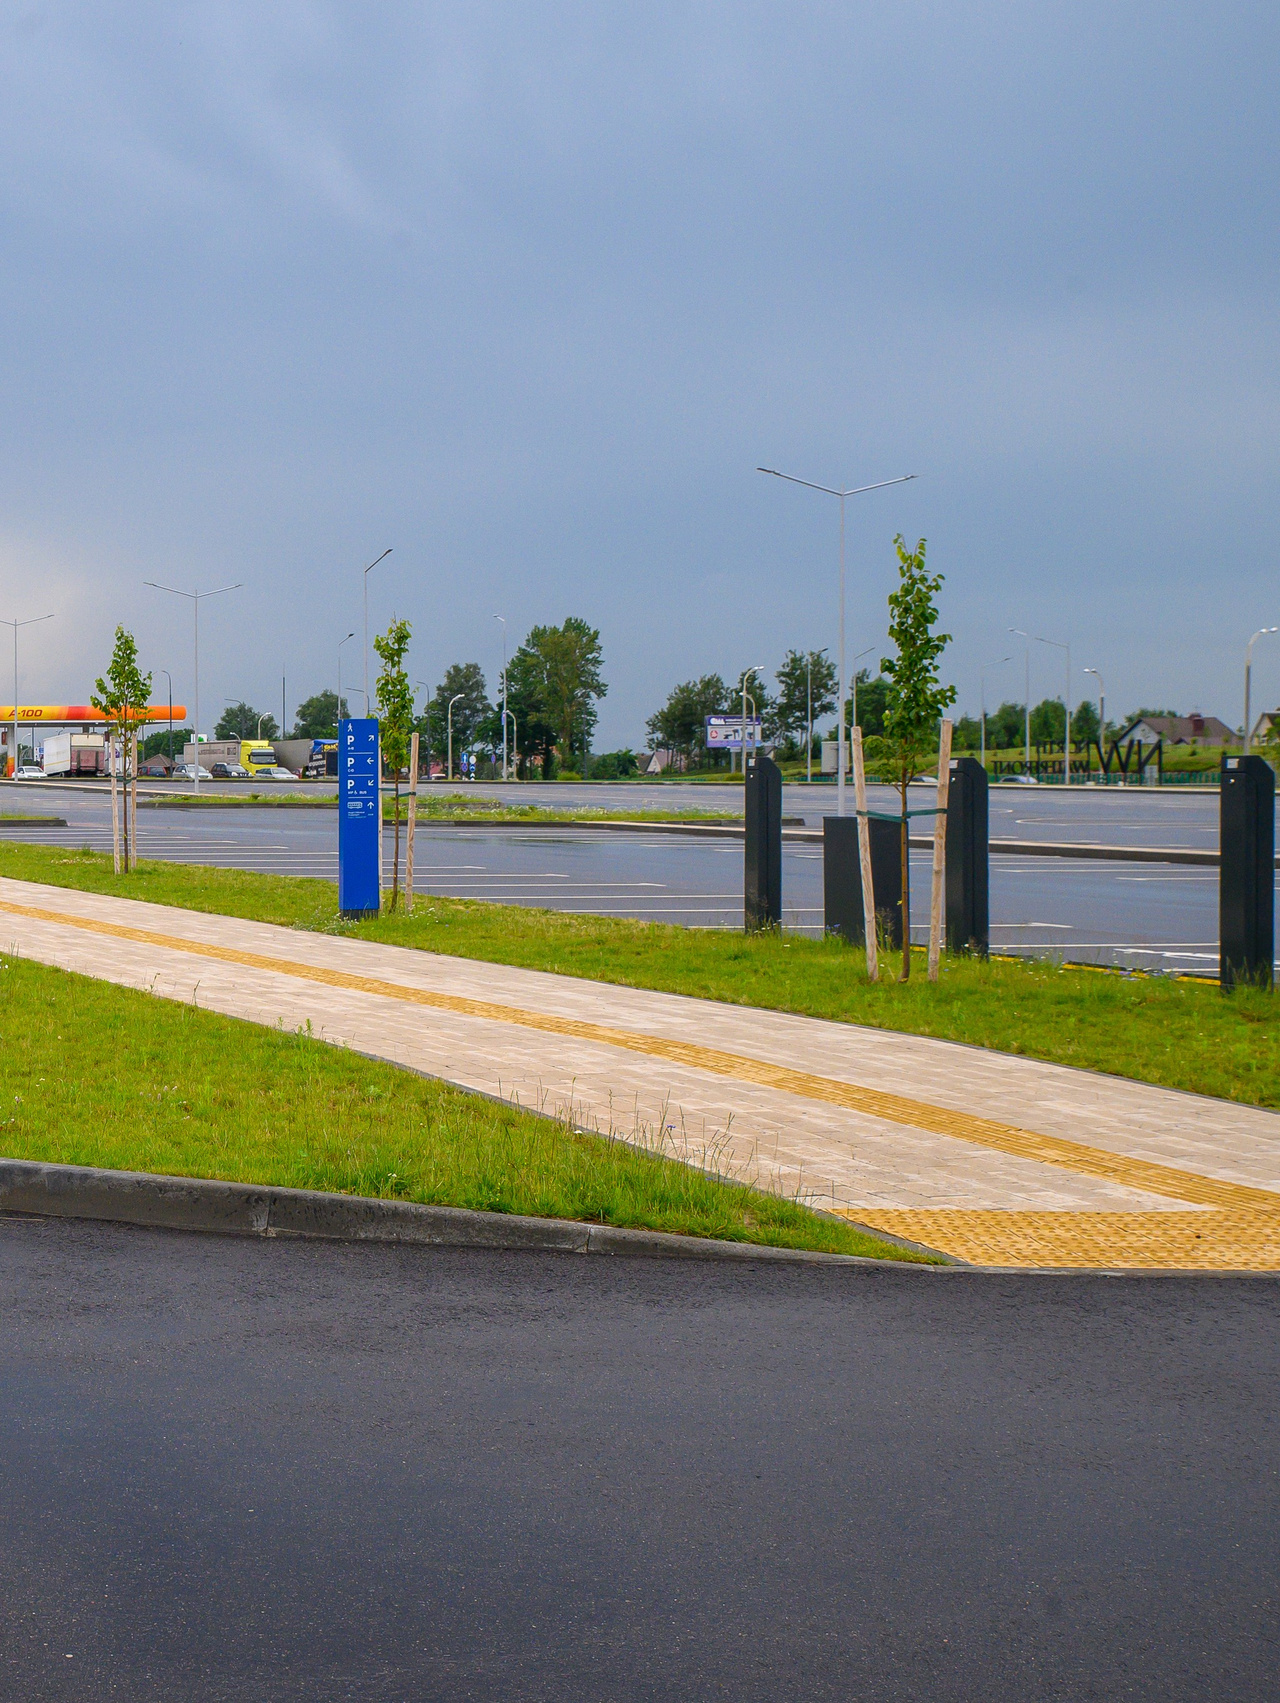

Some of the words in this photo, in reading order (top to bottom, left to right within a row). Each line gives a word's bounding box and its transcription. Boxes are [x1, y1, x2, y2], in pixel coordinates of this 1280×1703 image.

[8, 709, 43, 717] A-100
[347, 735, 355, 745] P
[347, 757, 355, 768] P
[347, 779, 355, 790] P
